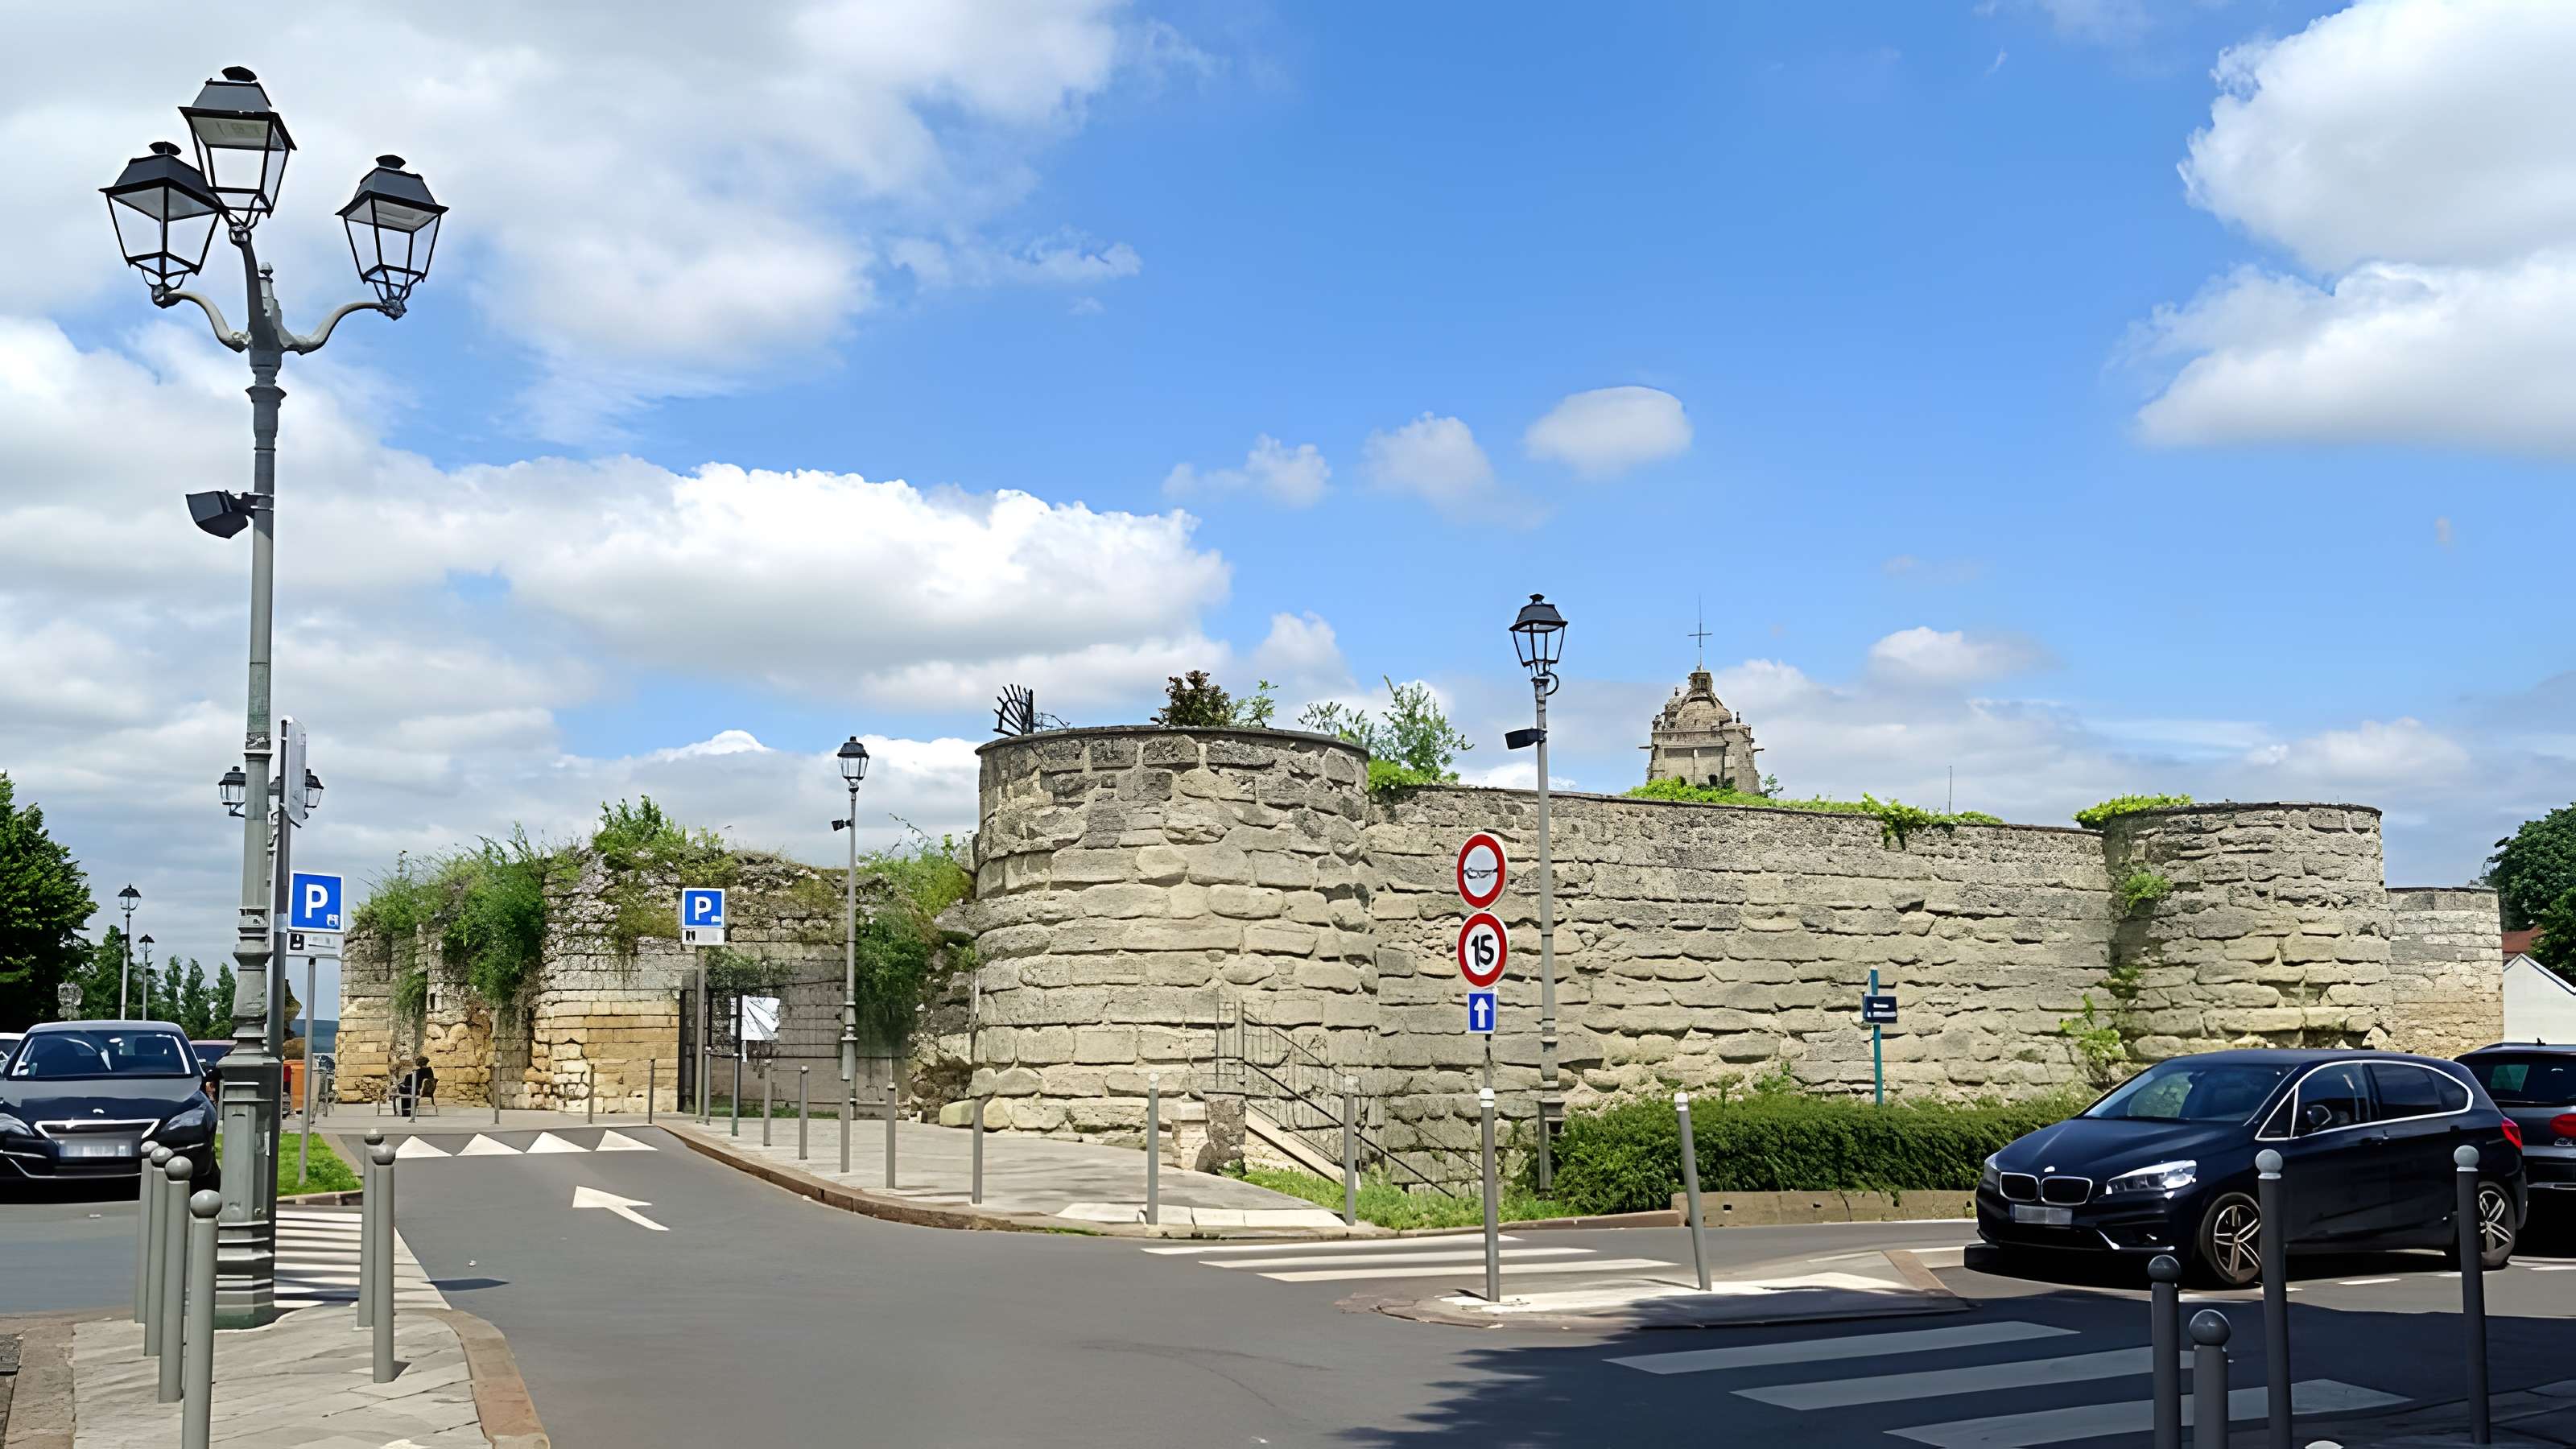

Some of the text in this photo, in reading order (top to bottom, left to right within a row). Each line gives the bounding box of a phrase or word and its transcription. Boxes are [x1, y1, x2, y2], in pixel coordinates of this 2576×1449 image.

[305, 883, 328, 919] P
[695, 896, 712, 921] P
[1471, 934, 1495, 967] 15
